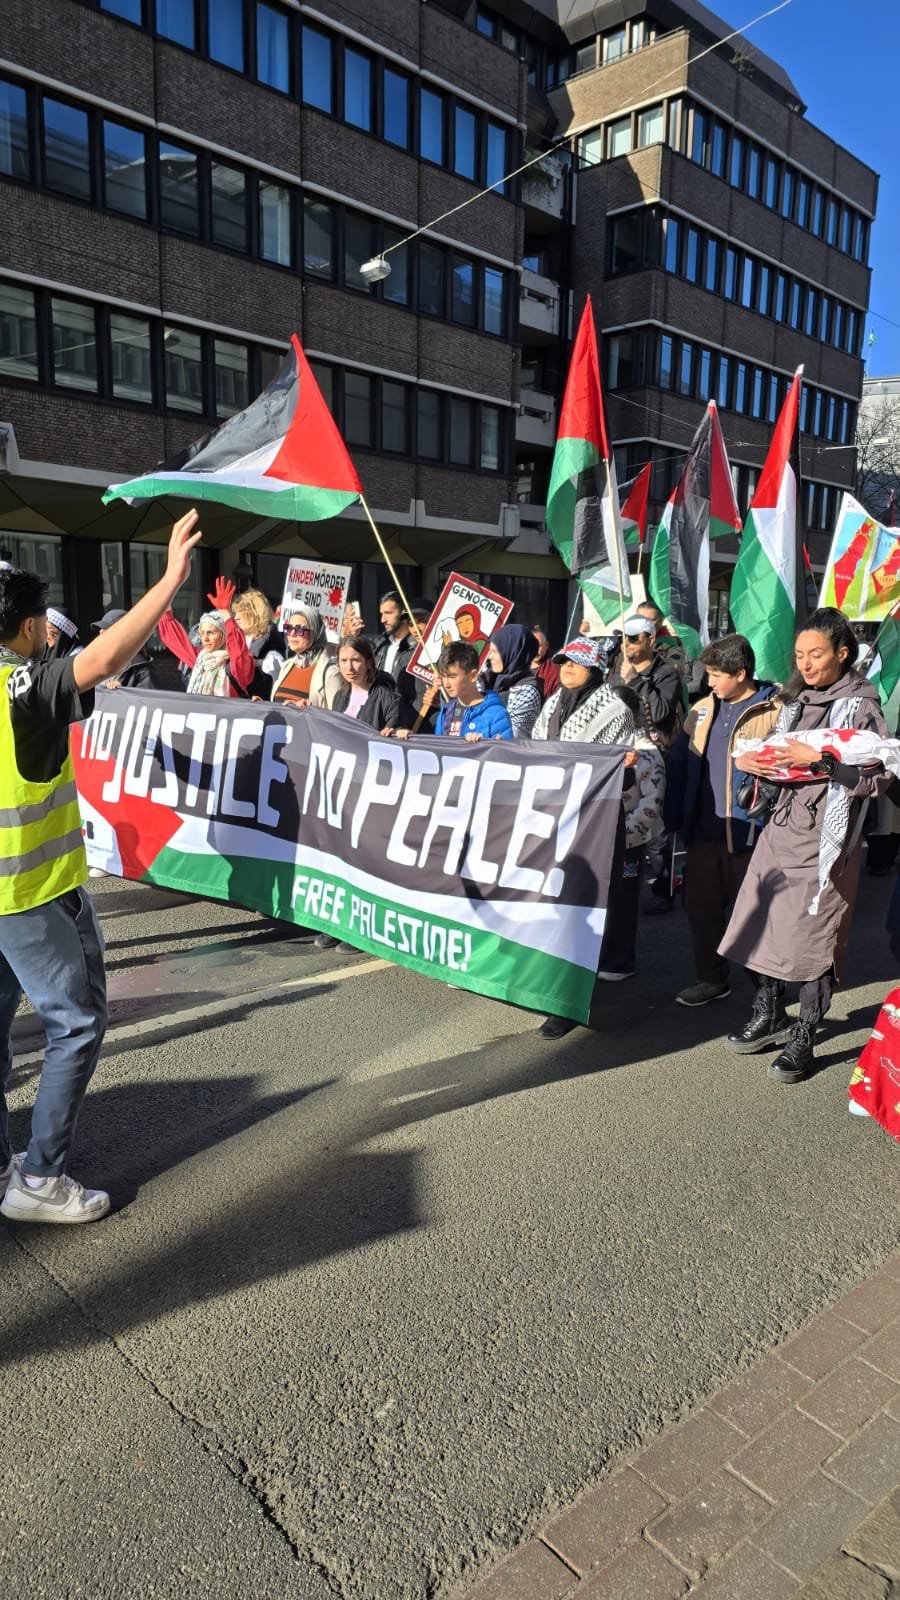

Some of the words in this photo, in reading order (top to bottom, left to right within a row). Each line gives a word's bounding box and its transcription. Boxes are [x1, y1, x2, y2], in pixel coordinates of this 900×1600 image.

[289, 568, 346, 590] KINDERMÖRDER
[304, 591, 322, 607] SIND
[452, 584, 502, 616] GENOCIDE
[81, 710, 118, 761] NO
[102, 705, 293, 828] JUSTICE
[302, 742, 357, 829] NO
[350, 741, 593, 897] PEACE!
[290, 874, 346, 926] FREE
[348, 893, 472, 972] PALESTINE!
